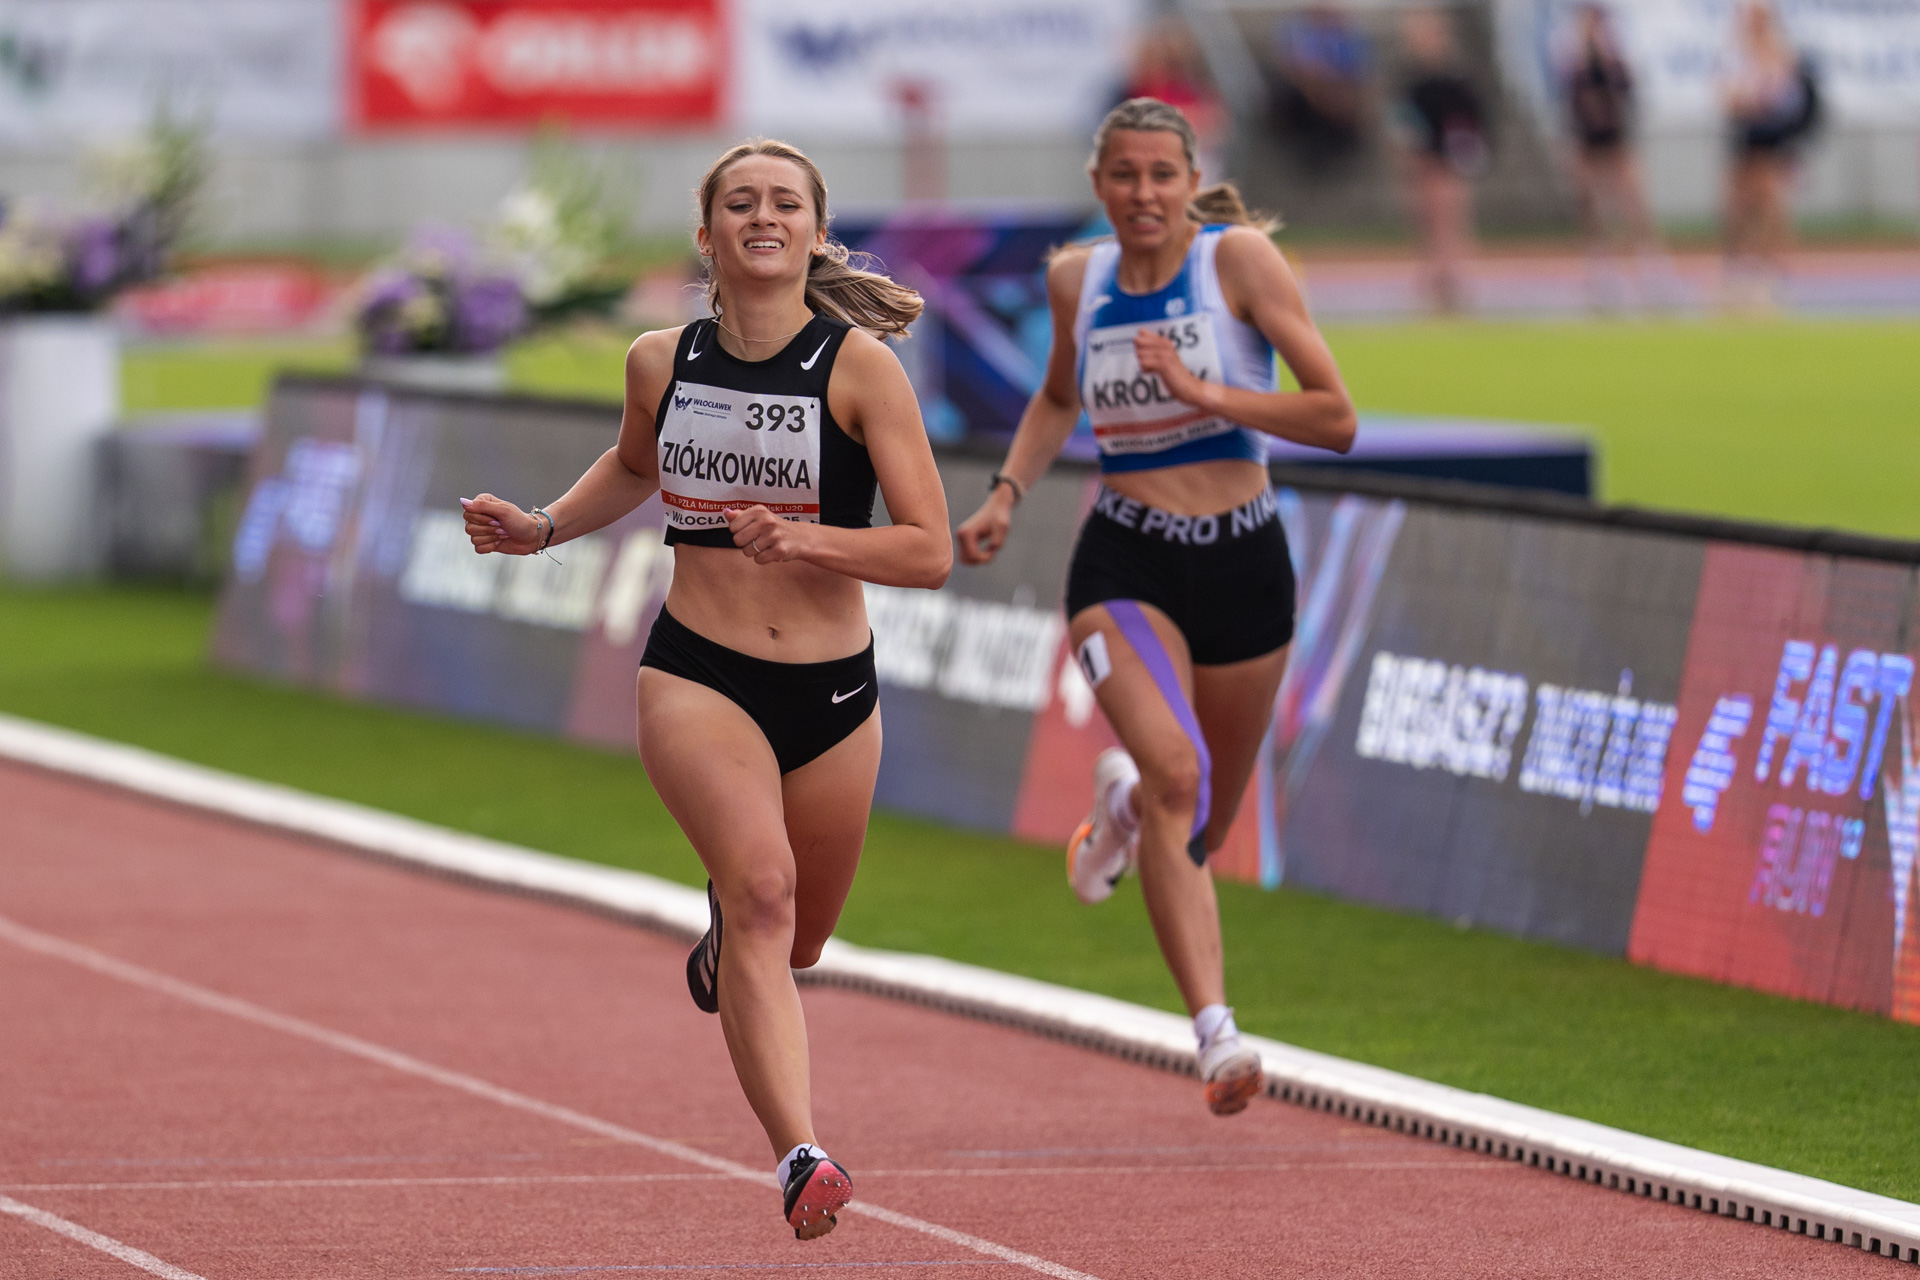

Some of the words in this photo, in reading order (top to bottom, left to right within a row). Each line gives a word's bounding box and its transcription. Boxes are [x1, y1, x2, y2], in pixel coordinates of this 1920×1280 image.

[1158, 322, 1200, 350] 65
[693, 398, 732, 411] WŁOCŁAWEK
[1093, 369, 1209, 410] KRÓL
[745, 403, 806, 433] 393
[662, 439, 812, 490] ZIÓŁKOWSKA
[672, 510, 726, 526] WŁOCŁA
[678, 498, 697, 509] PZLA
[1096, 486, 1144, 530] KE
[1141, 508, 1220, 545] PRO
[1231, 480, 1278, 538] NIK
[1754, 639, 1915, 801] FAST
